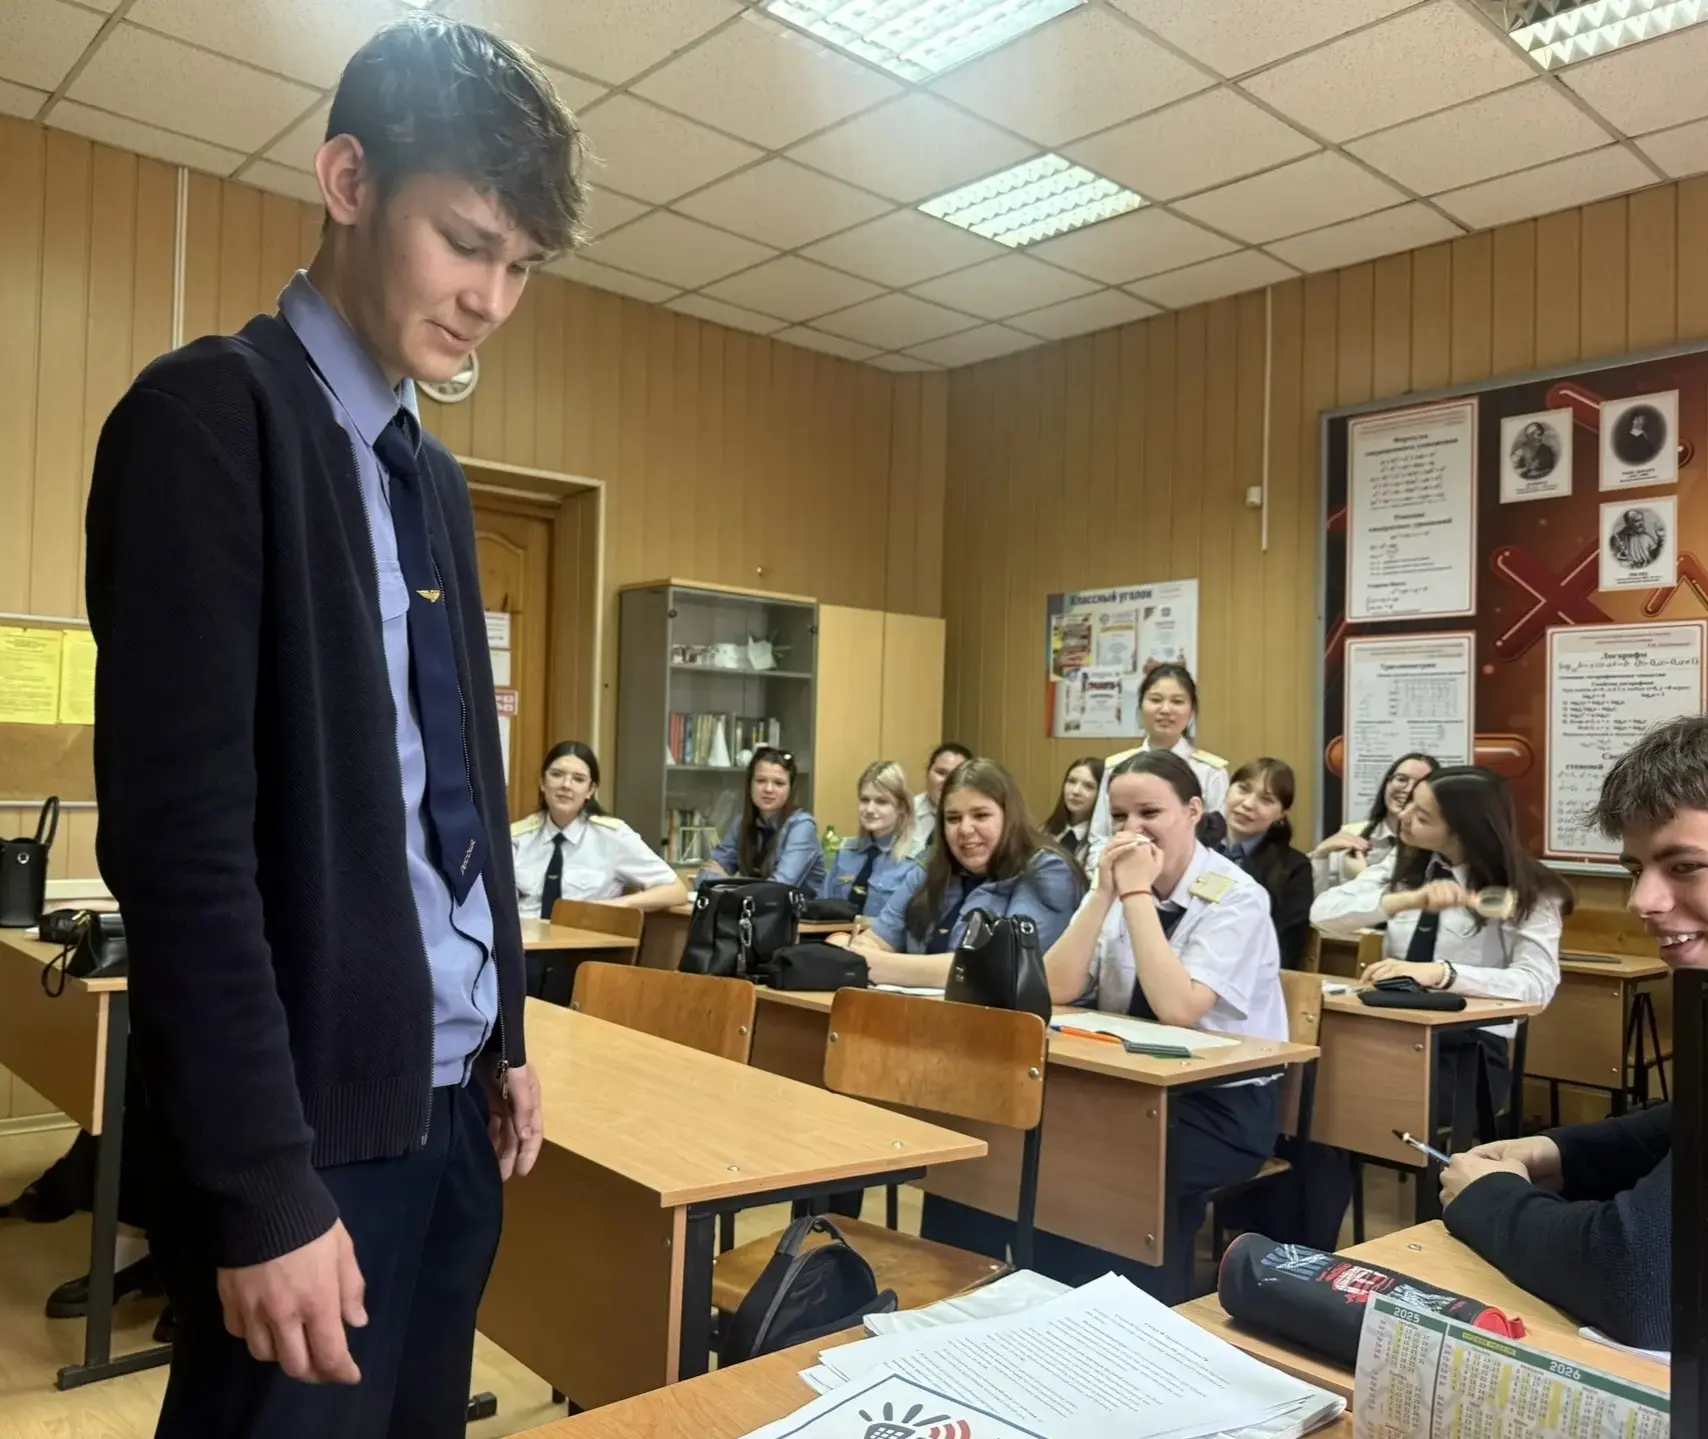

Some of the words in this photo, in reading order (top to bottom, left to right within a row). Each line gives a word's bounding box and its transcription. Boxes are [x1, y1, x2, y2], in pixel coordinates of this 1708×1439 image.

[1070, 590, 1117, 606] Классный
[1118, 589, 1152, 604] уголок
[1393, 1307, 1420, 1323] 2025
[1549, 1361, 1581, 1380] 2026
